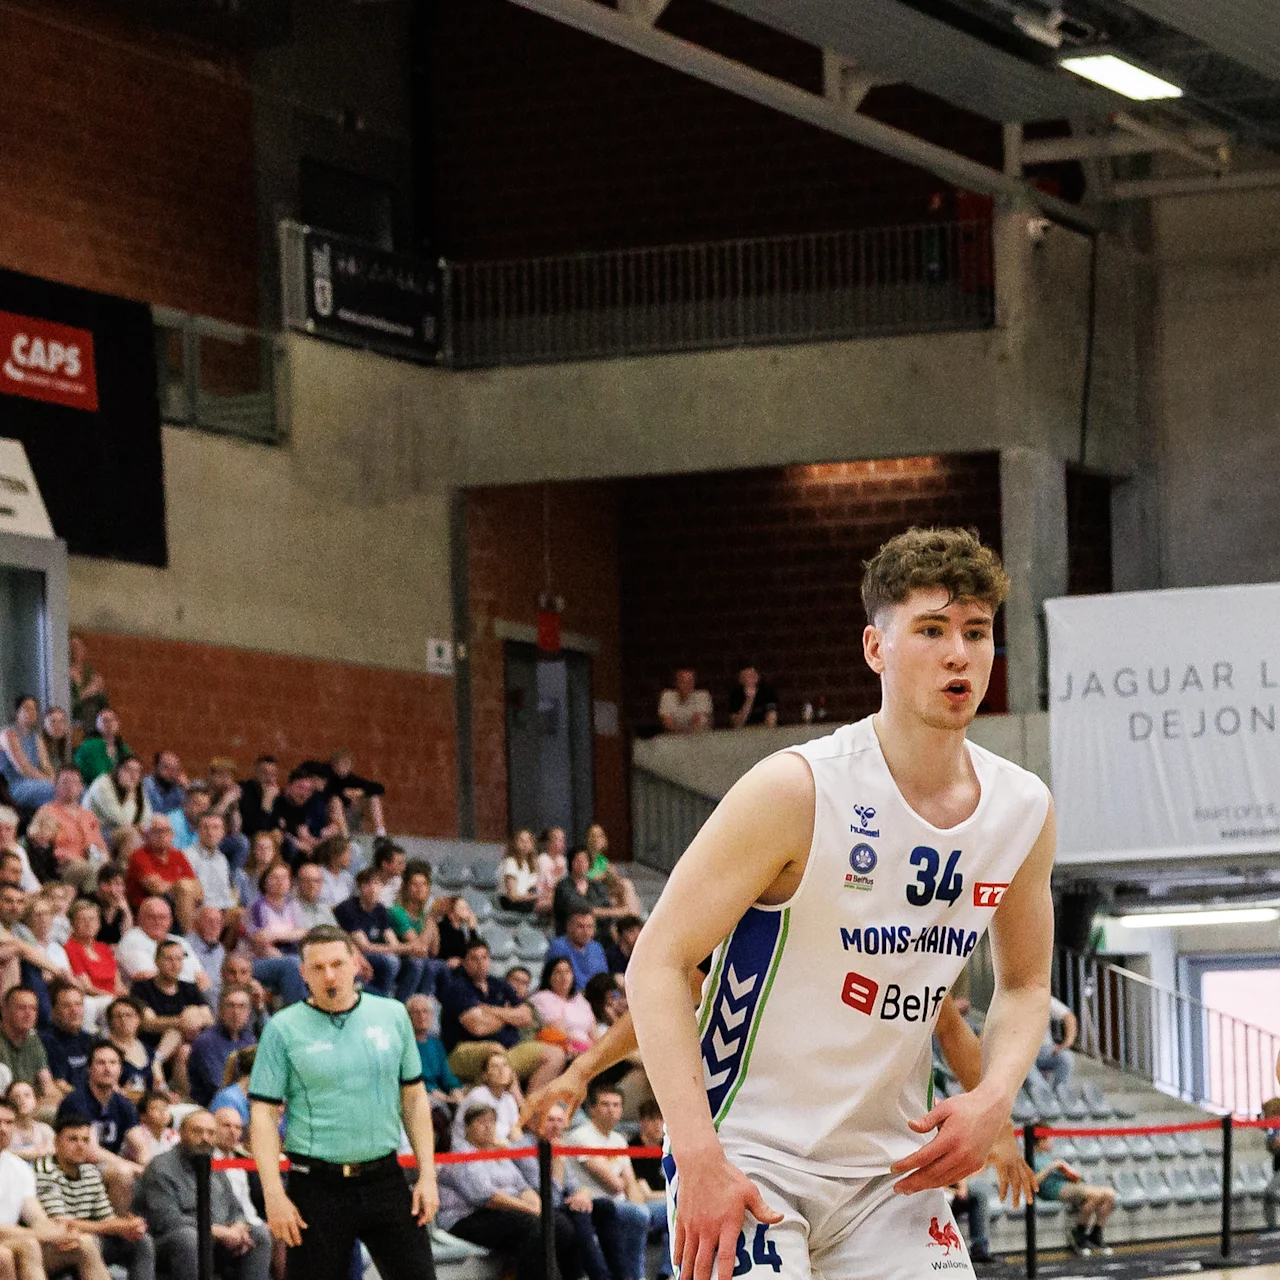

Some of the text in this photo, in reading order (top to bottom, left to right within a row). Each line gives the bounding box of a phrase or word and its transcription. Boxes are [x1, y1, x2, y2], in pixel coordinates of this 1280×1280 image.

[12, 332, 82, 378] CAPS
[1059, 660, 1234, 701] JAGUAR
[850, 824, 880, 838] hummel
[906, 846, 963, 907] 34
